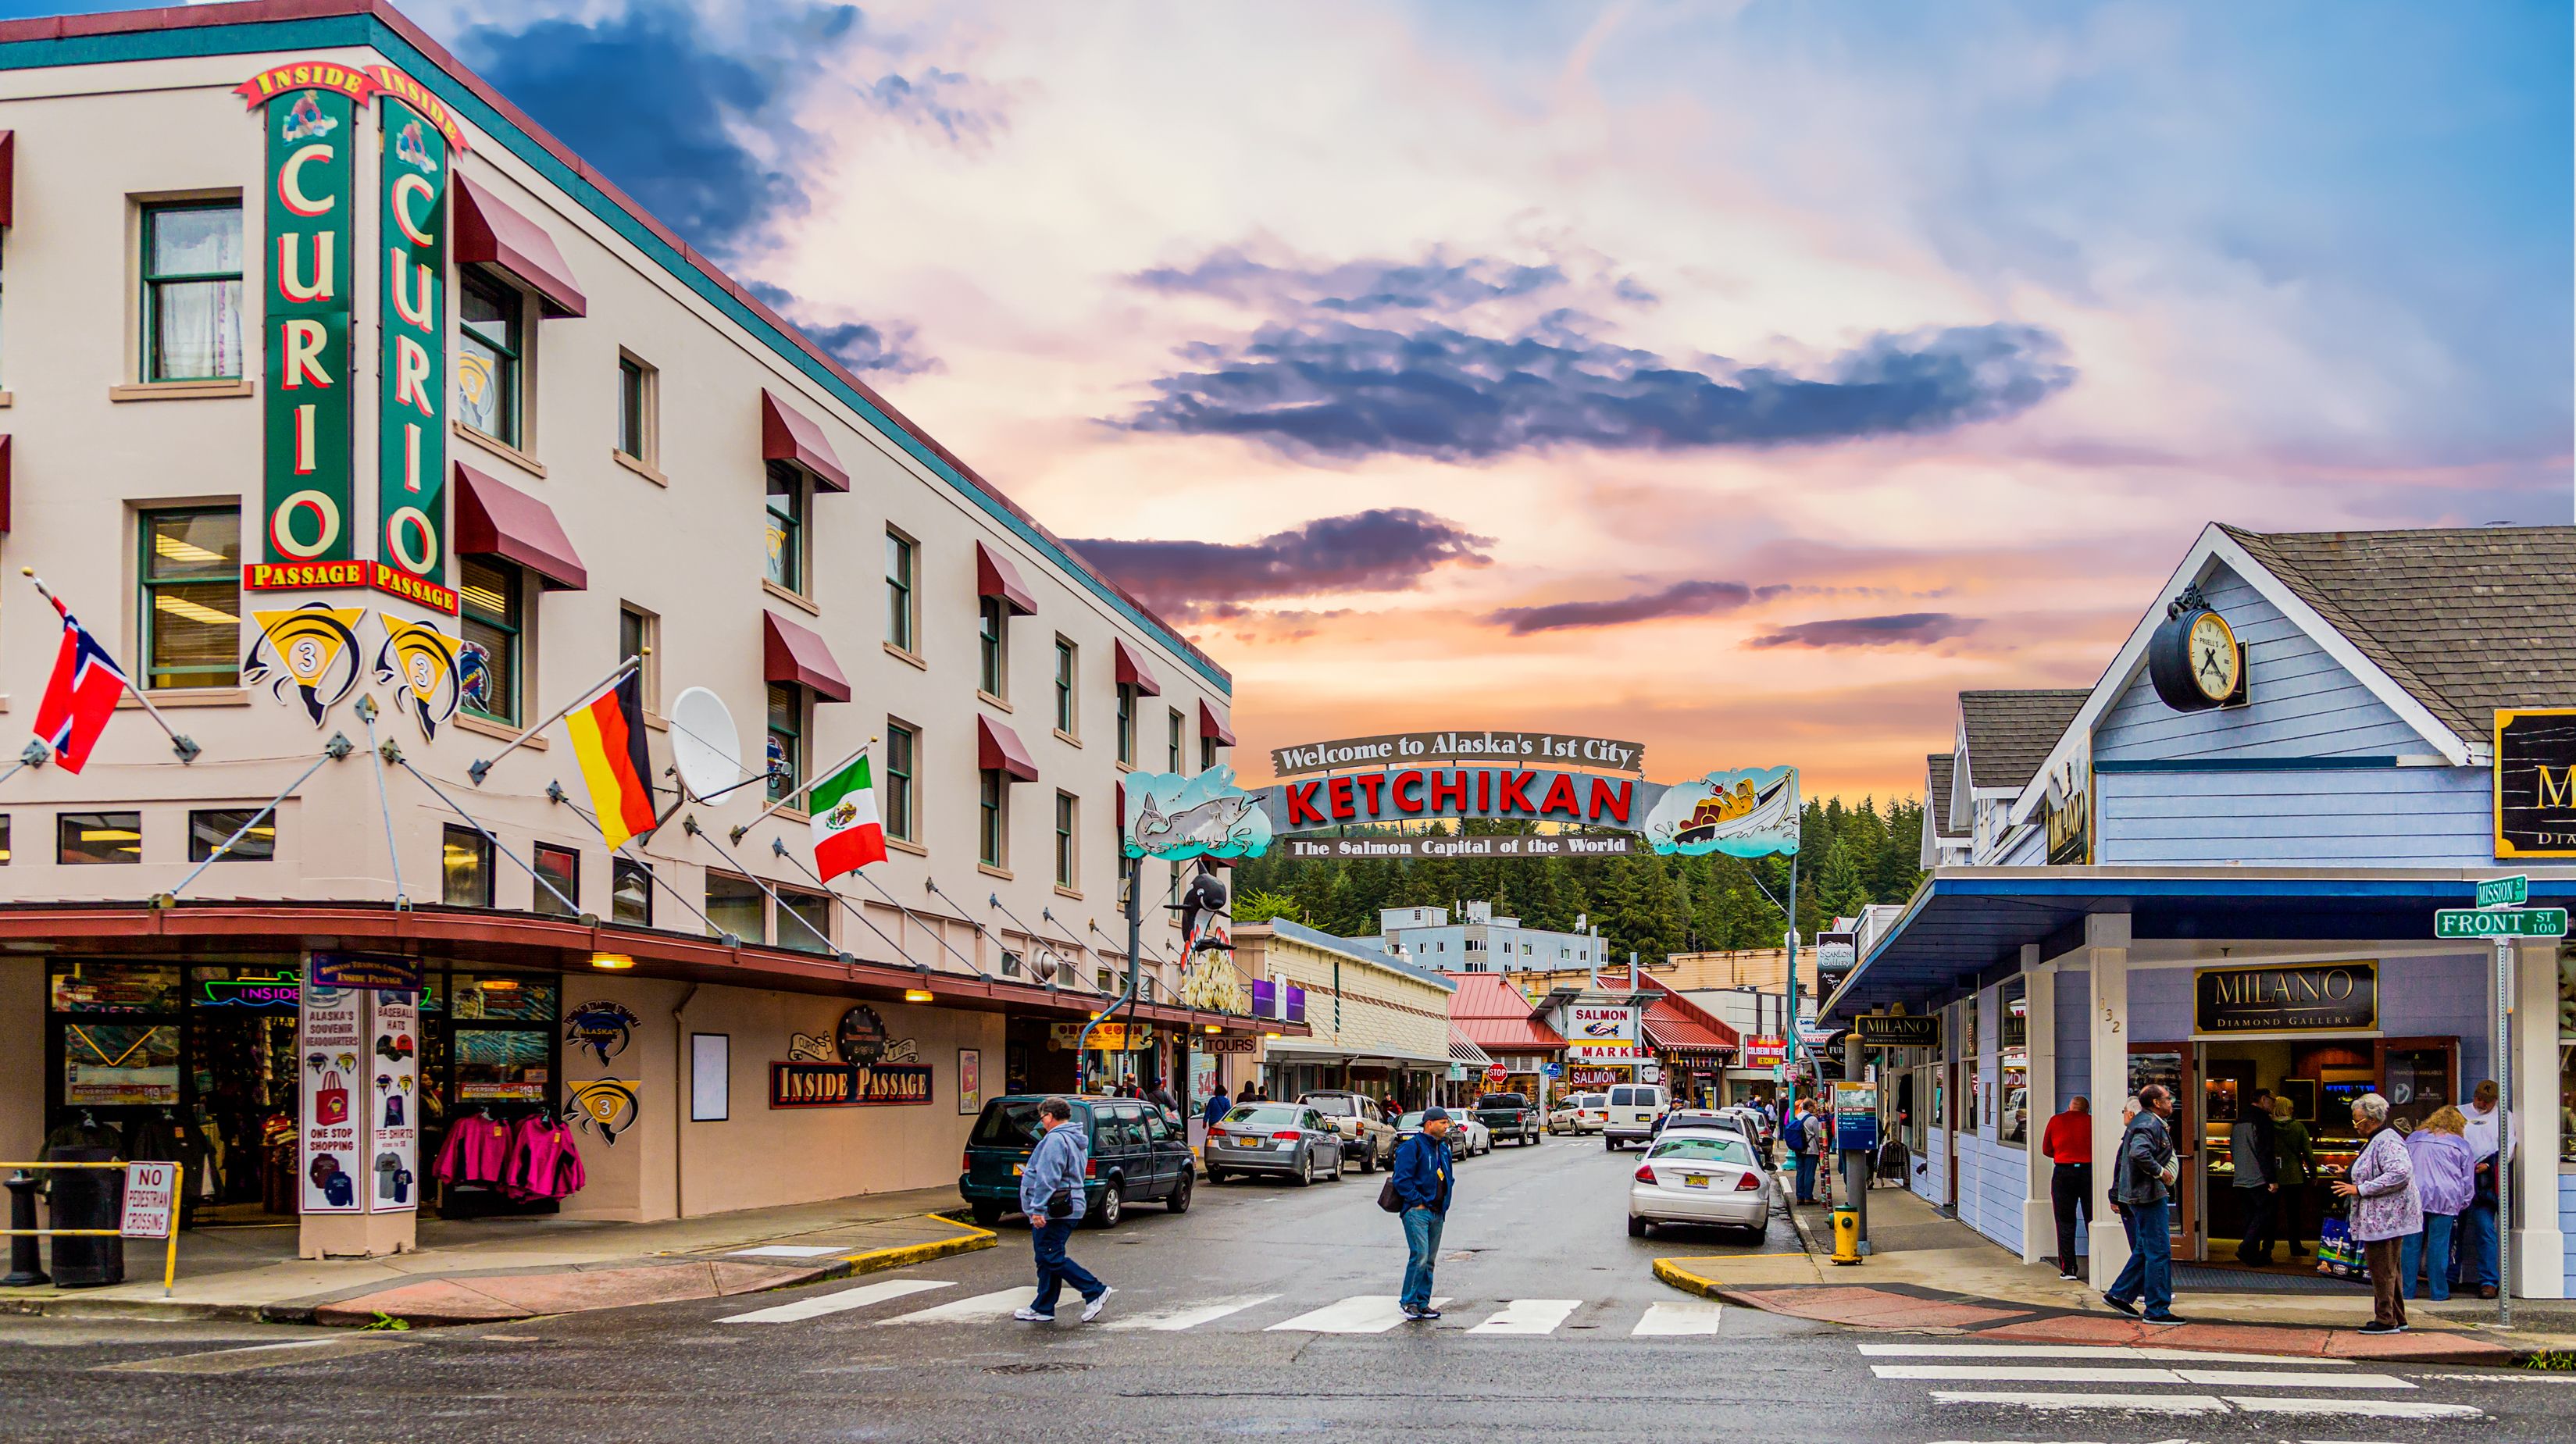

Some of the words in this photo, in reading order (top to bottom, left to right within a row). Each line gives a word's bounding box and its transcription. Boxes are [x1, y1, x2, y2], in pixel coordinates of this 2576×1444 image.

[256, 66, 363, 94] INSIDE
[379, 66, 458, 140] INSIDE
[271, 144, 341, 560] CURIO
[386, 173, 437, 576] CURIO
[253, 565, 361, 586] PASSAGE
[376, 565, 455, 611] PASSAGE
[298, 643, 317, 672] 3
[415, 658, 429, 687] 3
[1281, 744, 1392, 769] Welcome
[1400, 739, 1425, 755] to
[1432, 733, 1532, 755] Alaska's
[1541, 736, 1577, 758] 1st
[1583, 740, 1635, 769] City
[1285, 770, 1633, 826] KETCHIKAN
[1292, 841, 1330, 856] The
[1339, 840, 1412, 855] Salmon
[1422, 837, 1491, 857] Capital
[1500, 839, 1519, 854] of
[1528, 839, 1559, 854] the
[1568, 837, 1627, 853] World
[2478, 880, 2514, 904] MISSION
[2516, 878, 2524, 889] ST
[2442, 914, 2524, 933] FRONT
[2536, 911, 2553, 922] ST
[2532, 923, 2556, 933] 100
[241, 988, 300, 1000] INSIDE
[2214, 969, 2354, 1005] MILANO
[309, 1011, 354, 1021] ALASKA'S
[378, 1007, 413, 1018] BASEBALL
[1576, 1009, 1628, 1021] SALMON
[2100, 998, 2121, 1033] 132
[2217, 1018, 2281, 1028] DIAMOND
[2289, 1015, 2352, 1025] GALLERY
[310, 1024, 353, 1034] SOUVENIR
[387, 1021, 405, 1031] HATS
[1867, 1019, 1929, 1033] MILANO
[305, 1036, 359, 1047] HEADQUARTERS
[799, 1036, 820, 1056] CURIOS
[1206, 1039, 1254, 1052] TOURS
[1582, 1046, 1655, 1057] MARKET
[780, 1068, 848, 1100] INSIDE
[858, 1068, 926, 1099] PASSAGE
[1573, 1071, 1616, 1084] SALMON
[599, 1100, 611, 1116] 3
[311, 1128, 328, 1139] ONE
[331, 1128, 353, 1138] STOP
[375, 1129, 387, 1139] TEE
[389, 1128, 413, 1139] SHIRTS
[310, 1141, 353, 1152] SHOPPING
[139, 1168, 162, 1186] NO
[129, 1190, 168, 1208] PEDESTRIAN
[126, 1212, 164, 1230] CROSSING
